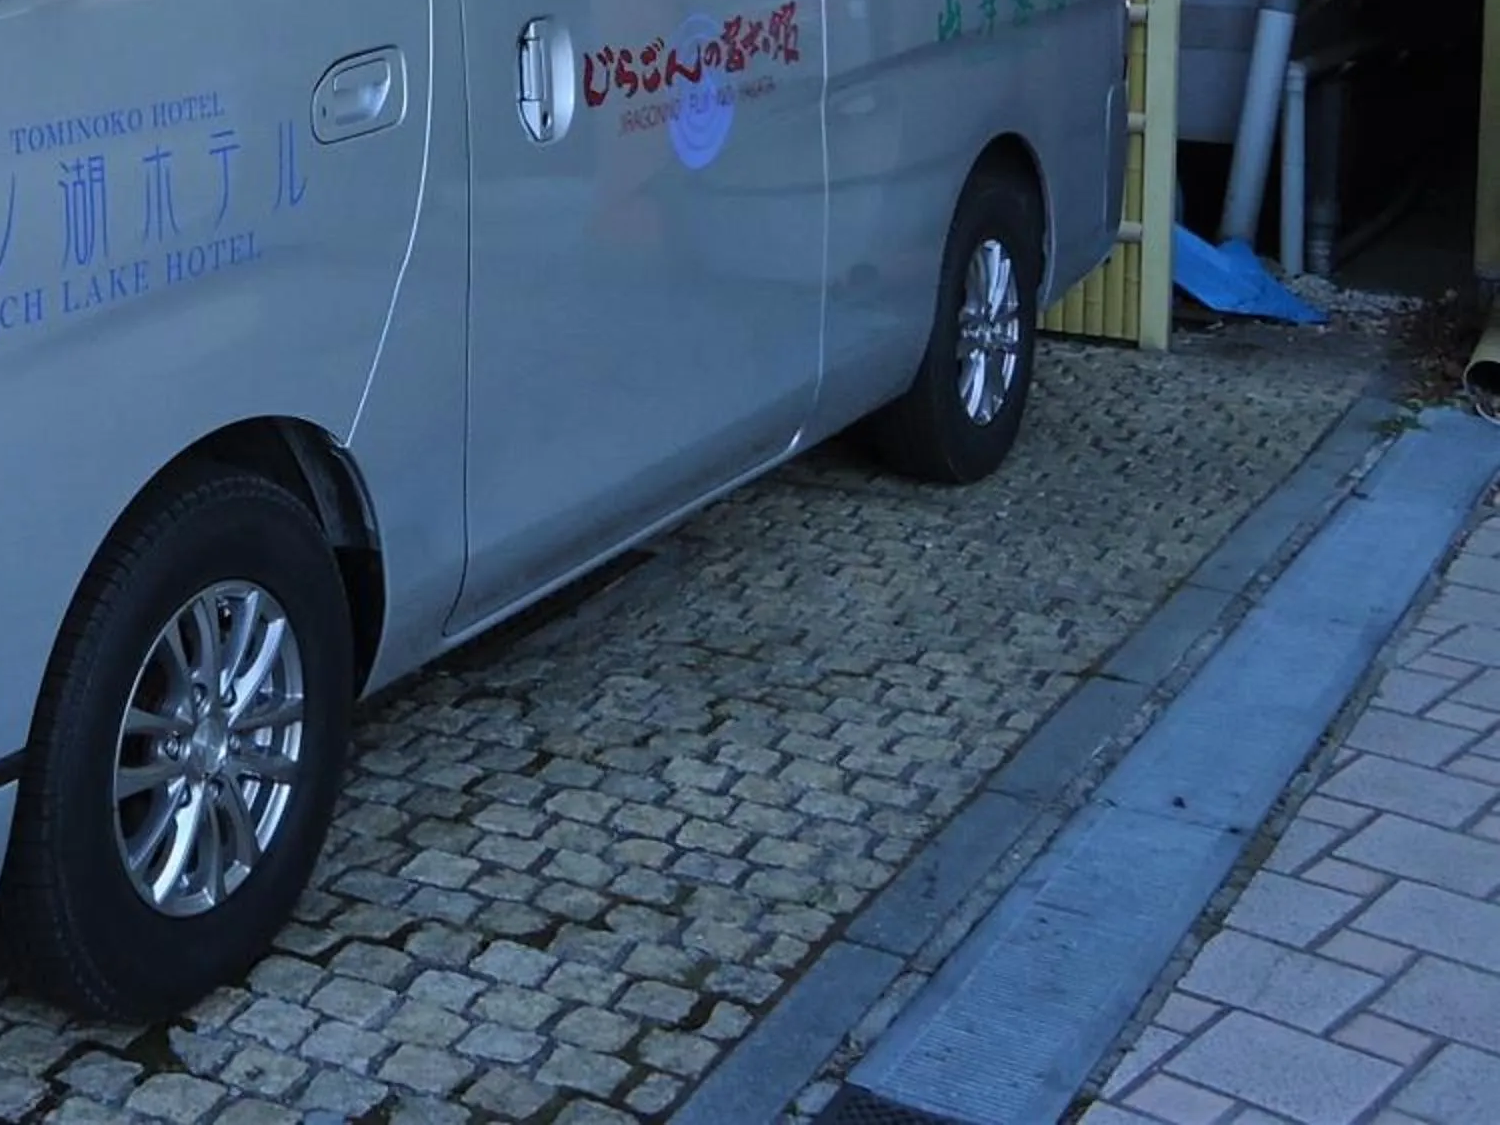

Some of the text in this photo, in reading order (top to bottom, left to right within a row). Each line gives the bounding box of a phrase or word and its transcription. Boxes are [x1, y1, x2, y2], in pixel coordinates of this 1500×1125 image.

[10, 91, 225, 155] TOMINOKO HOTEL
[62, 260, 150, 314] LAKE
[166, 232, 262, 286] HOTEL
